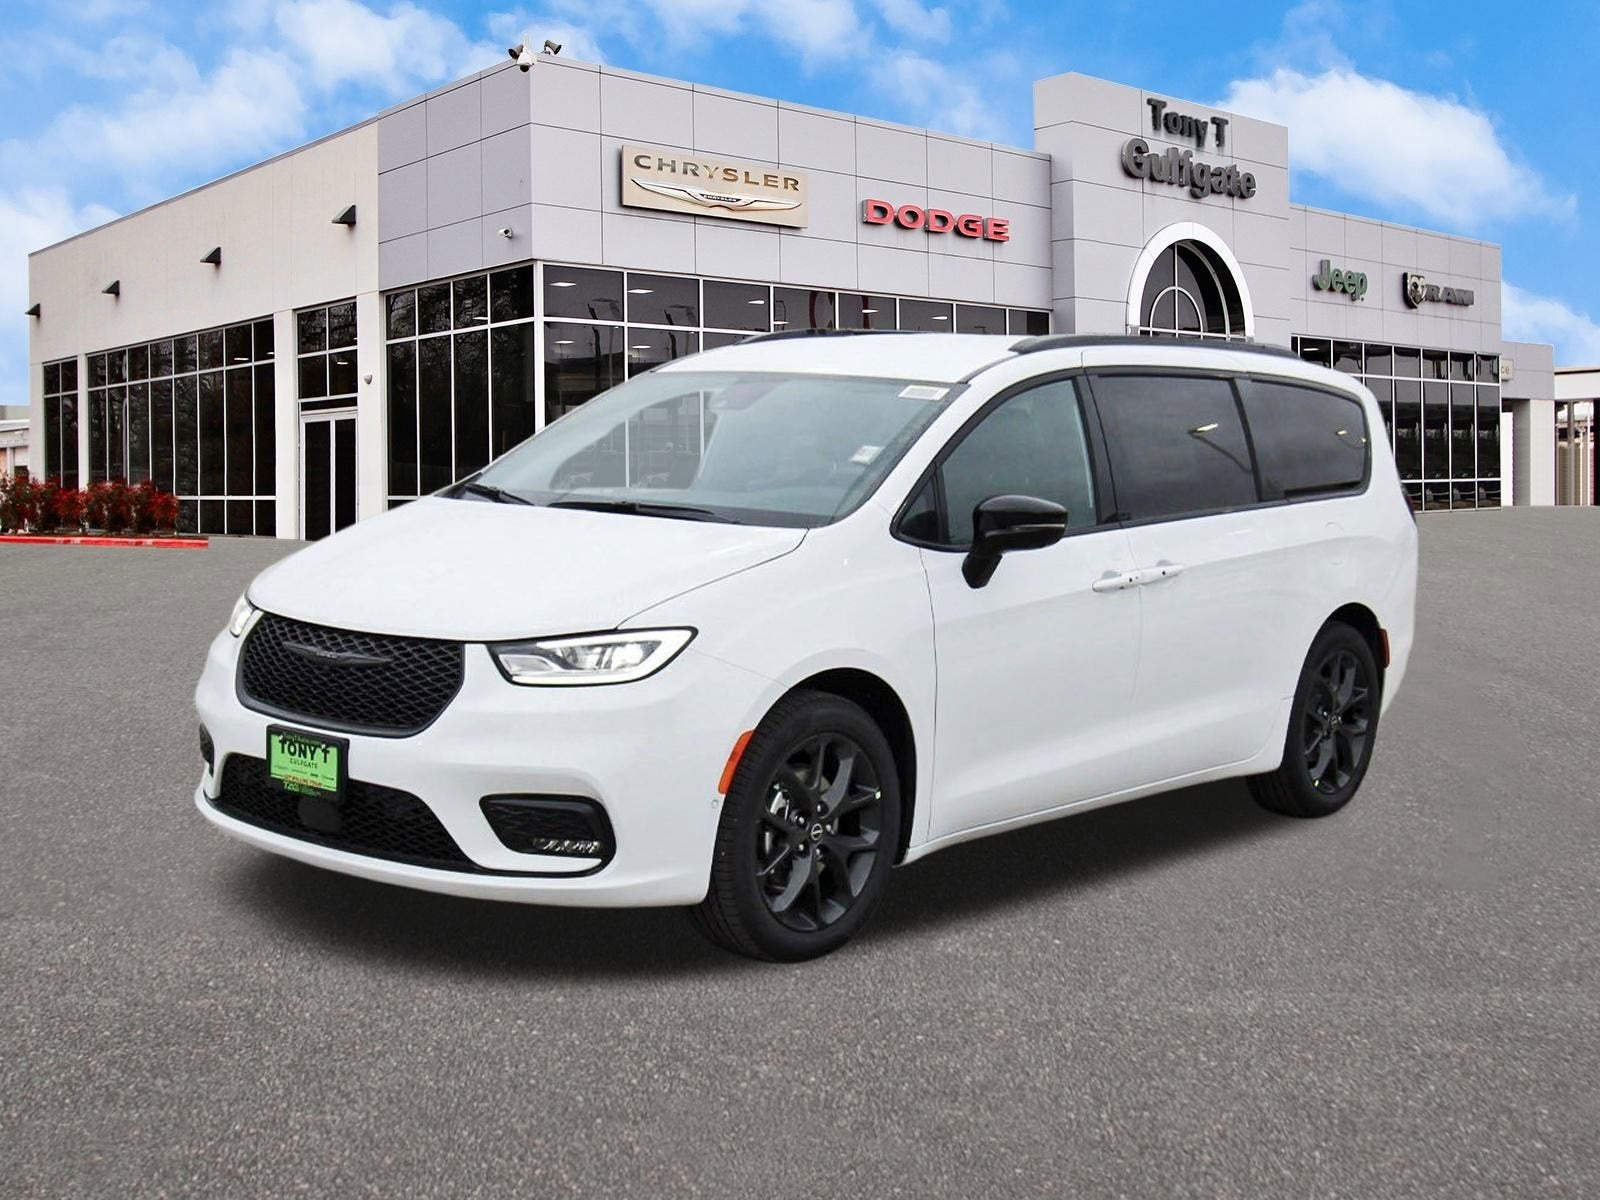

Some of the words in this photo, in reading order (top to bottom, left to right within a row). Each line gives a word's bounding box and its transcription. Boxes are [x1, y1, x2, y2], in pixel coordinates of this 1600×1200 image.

[1147, 97, 1208, 148] Tony
[1211, 116, 1229, 147] T
[634, 153, 800, 192] CHRYSLER
[1121, 137, 1257, 199] Gulfgate
[862, 198, 1011, 242] DODGE
[1312, 259, 1368, 302] Jeep
[1425, 284, 1475, 307] RAM
[279, 736, 319, 761] TONY
[321, 744, 330, 764] T
